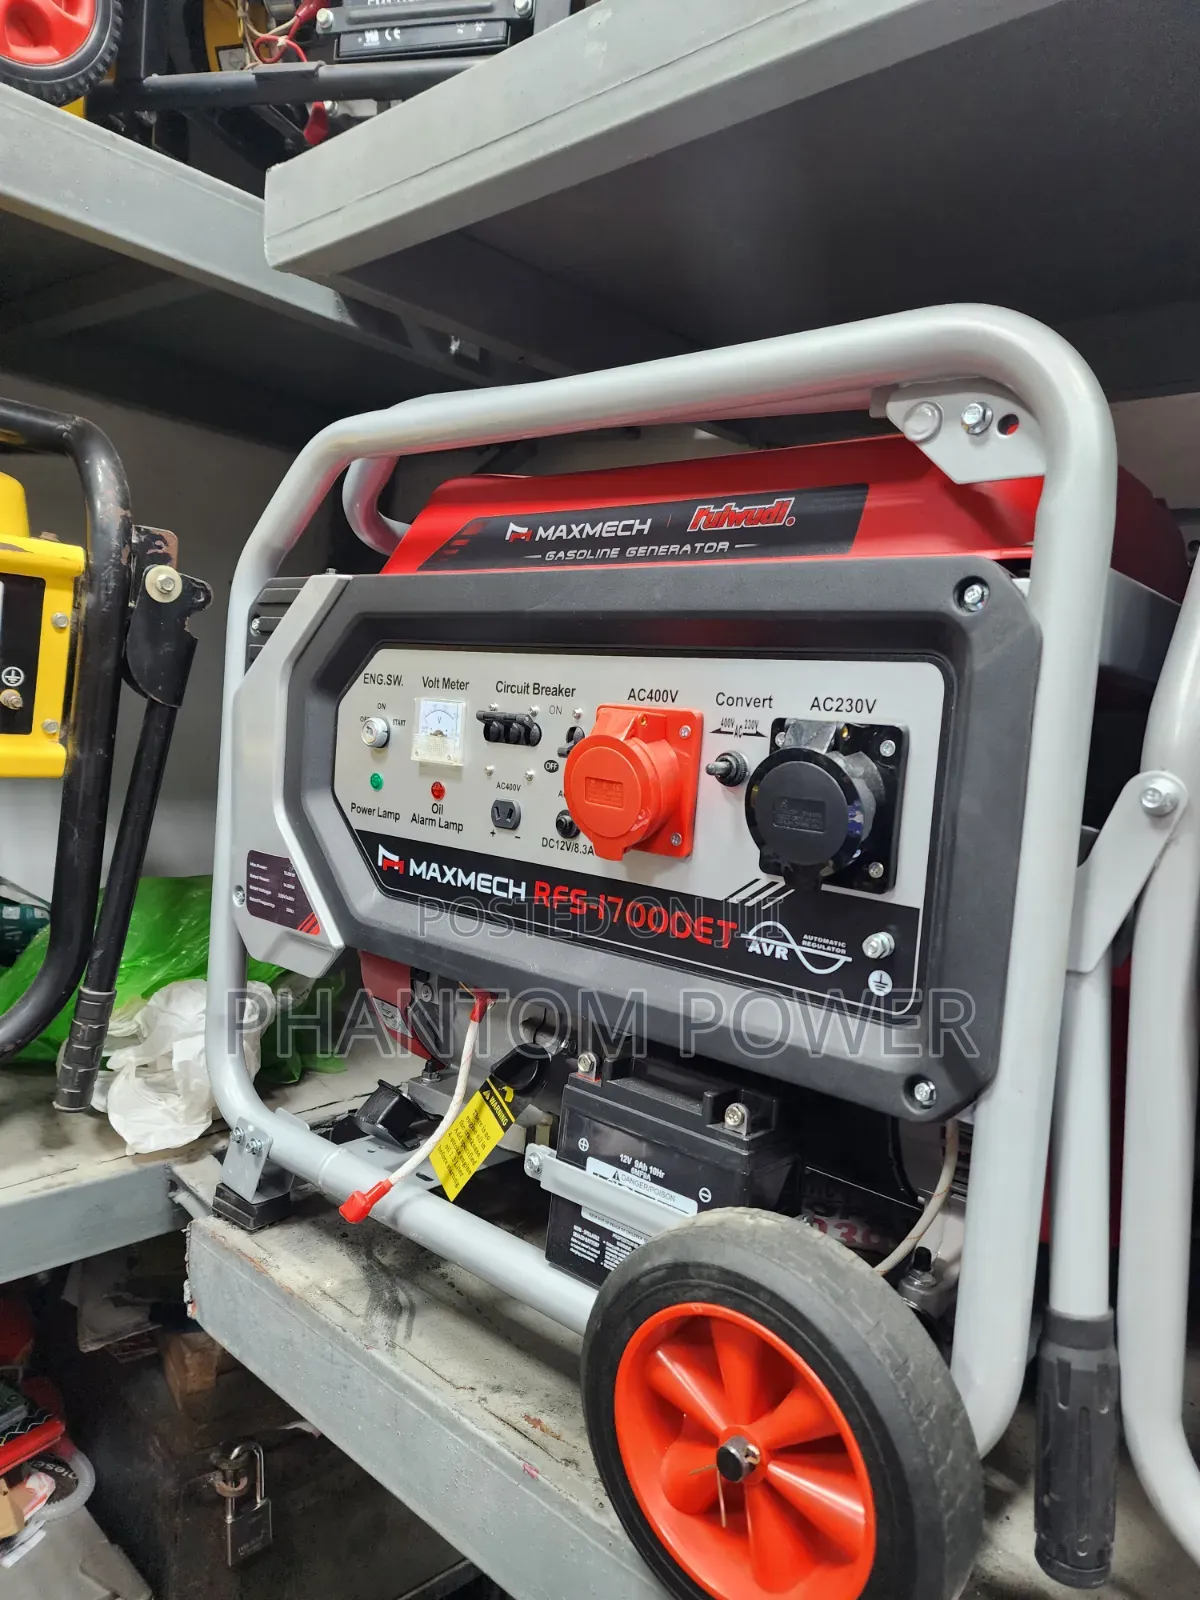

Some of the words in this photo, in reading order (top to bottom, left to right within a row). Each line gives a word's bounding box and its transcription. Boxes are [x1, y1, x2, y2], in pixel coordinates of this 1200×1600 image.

[535, 518, 652, 541] MAXMECH
[544, 548, 620, 561] GASOLINE
[625, 542, 730, 557] GENERATOR
[363, 673, 404, 686] ENG.SW.
[422, 676, 440, 689] Volt
[442, 677, 470, 690] Meter
[495, 681, 530, 695] Circuit
[532, 683, 576, 698] Breaker
[627, 687, 679, 704] AC400V
[377, 702, 387, 710] ON
[715, 692, 773, 708] Convert
[809, 696, 877, 714] AC230V
[549, 705, 563, 715] ON
[733, 725, 743, 738] AC
[350, 802, 376, 816] Power
[377, 807, 401, 823] Lamp
[431, 803, 444, 815] Oil
[410, 813, 437, 827] Alarm
[438, 817, 464, 834] Lamp
[541, 837, 595, 856] DC12V/8.3A
[408, 857, 527, 902] MAXMECH
[801, 940, 847, 955] REGULATOR
[802, 934, 847, 948] AUTOMATIC
[748, 940, 789, 961] AVR
[489, 1096, 508, 1126] WARNING
[619, 1153, 633, 1165] 12V
[621, 1174, 676, 1202] DANGER/POISON
